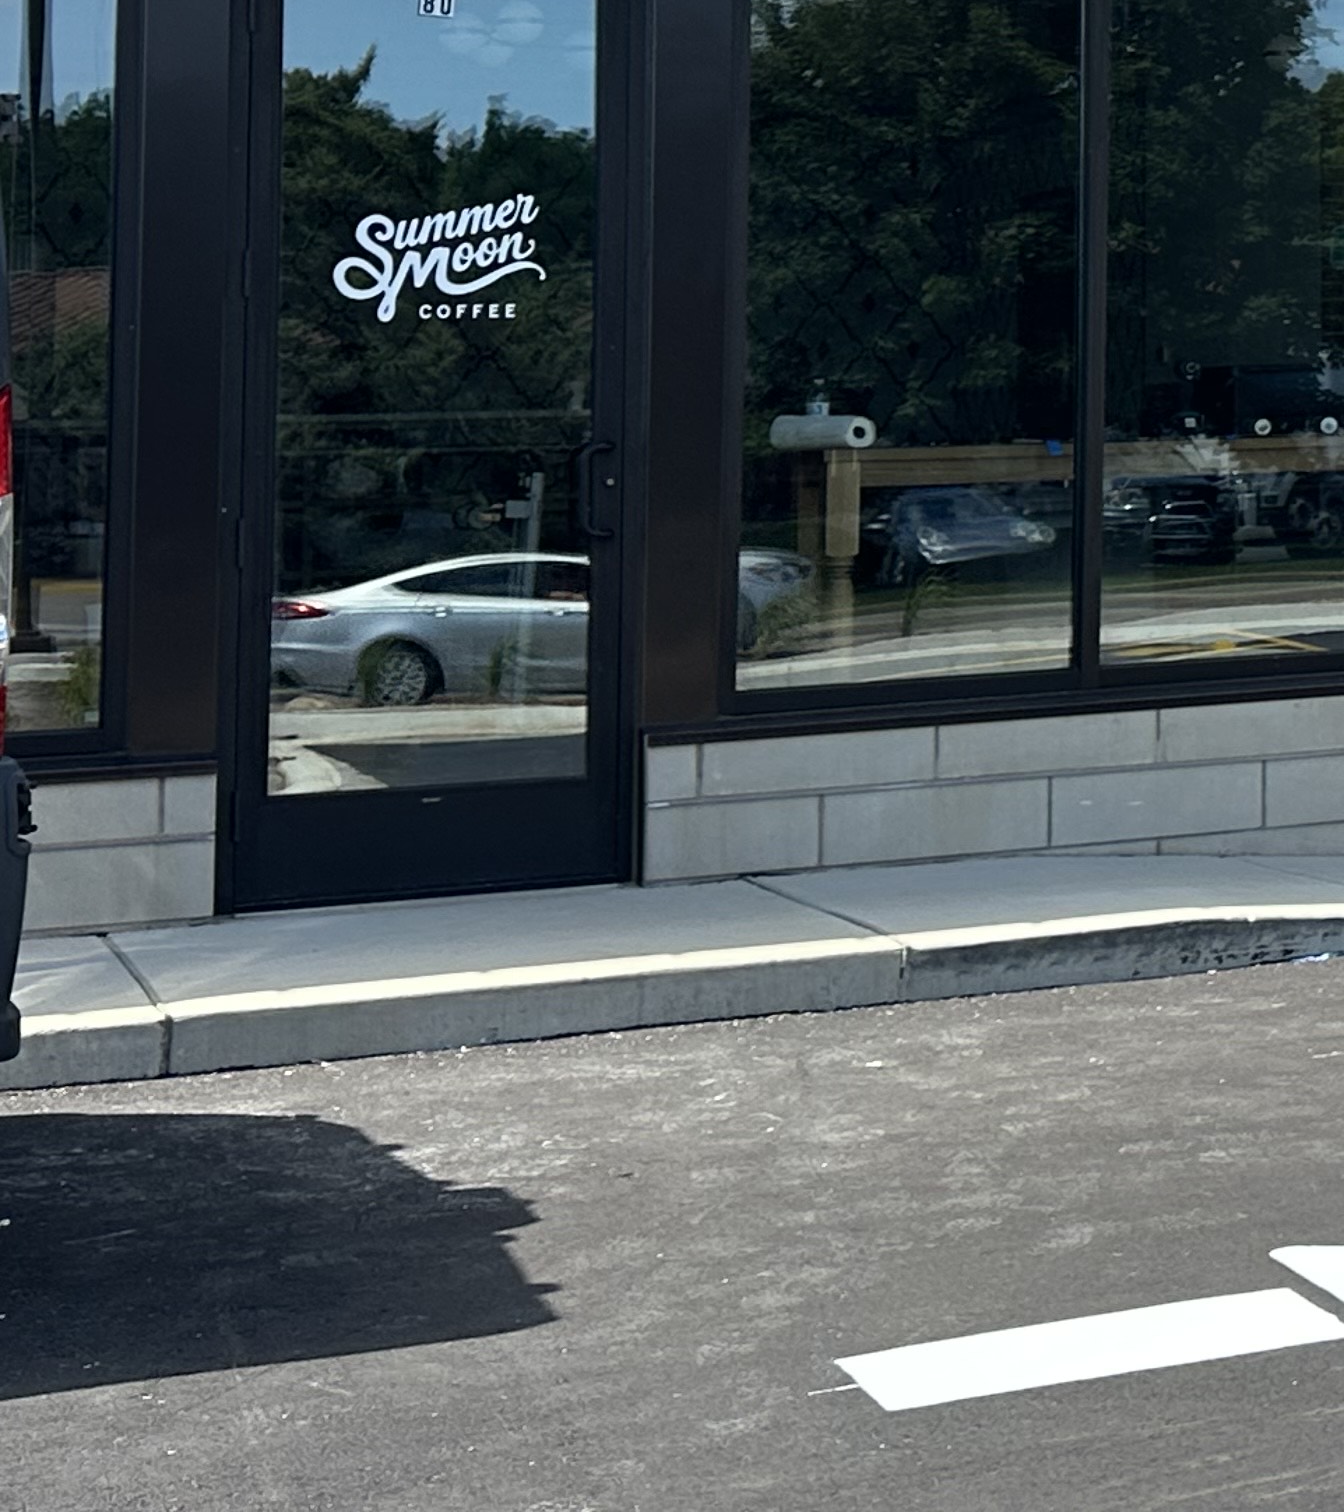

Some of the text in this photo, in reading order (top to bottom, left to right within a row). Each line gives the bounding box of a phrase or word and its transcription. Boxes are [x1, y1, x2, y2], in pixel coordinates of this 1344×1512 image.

[333, 193, 540, 300] Summer
[377, 231, 546, 323] Moon
[418, 303, 516, 320] COFFEE
